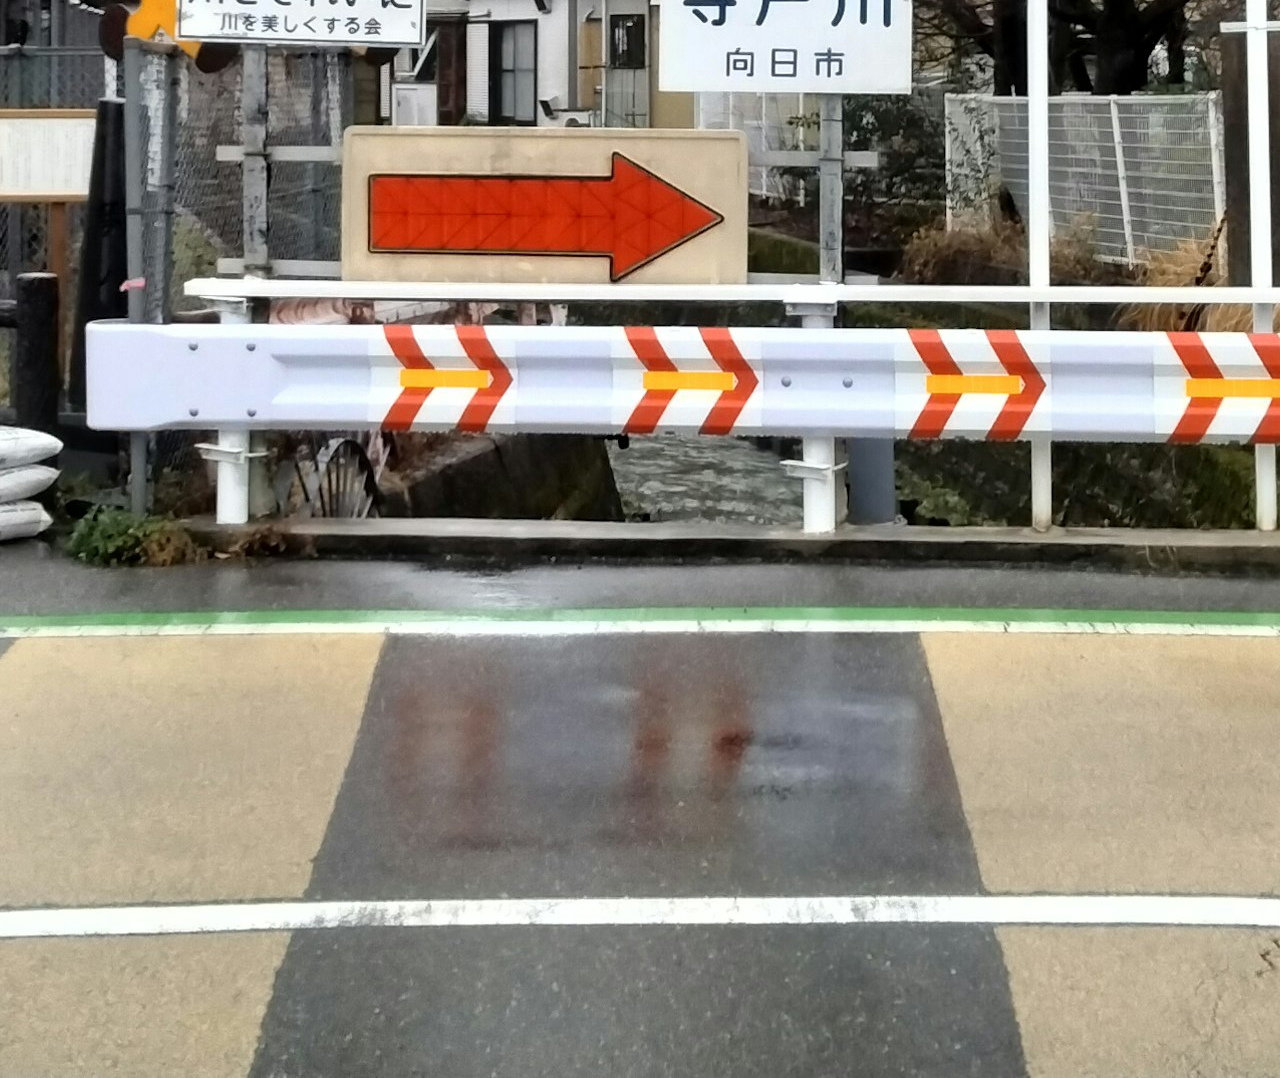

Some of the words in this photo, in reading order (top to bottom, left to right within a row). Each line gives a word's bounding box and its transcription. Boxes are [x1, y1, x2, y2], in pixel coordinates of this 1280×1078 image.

[219, 12, 382, 36] 川を美しくする会
[725, 47, 845, 78] 向日市
